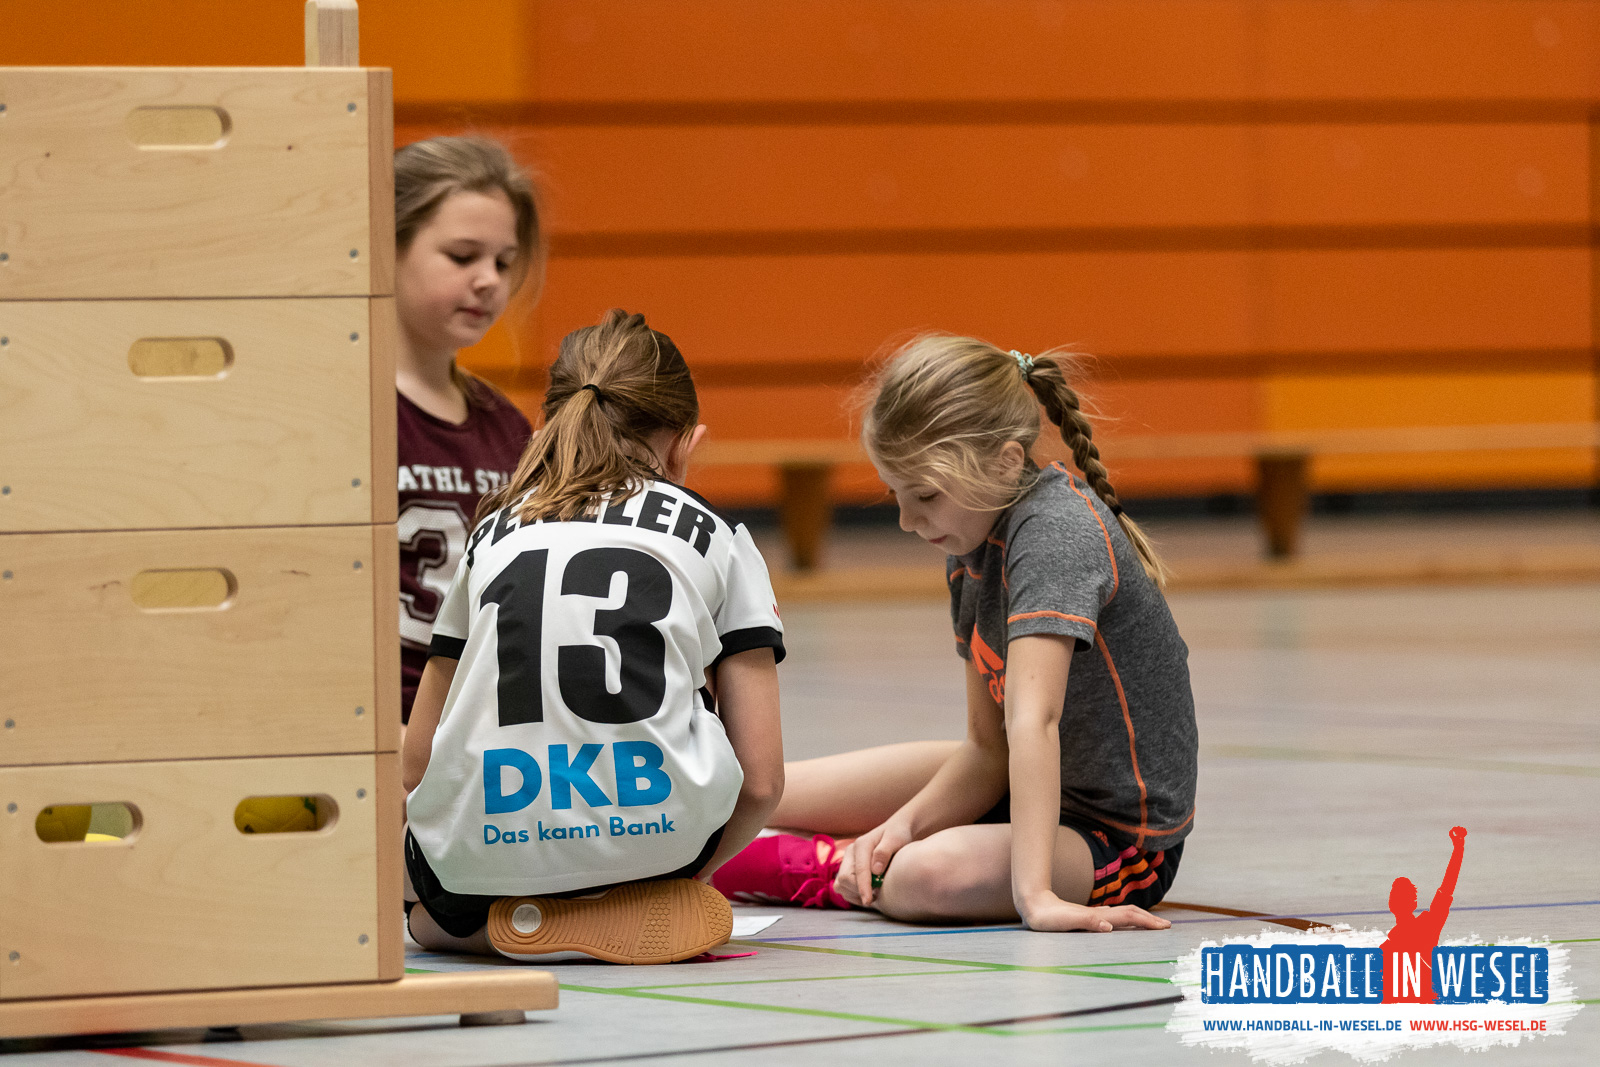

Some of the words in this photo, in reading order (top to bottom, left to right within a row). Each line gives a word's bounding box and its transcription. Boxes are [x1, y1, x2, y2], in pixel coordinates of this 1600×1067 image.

[398, 464, 472, 494] ATHL
[475, 468, 514, 495] ST
[479, 547, 673, 727] 13
[483, 740, 673, 815] DKB
[483, 824, 530, 845] Das
[537, 820, 600, 841] kann
[609, 813, 676, 837] Bank
